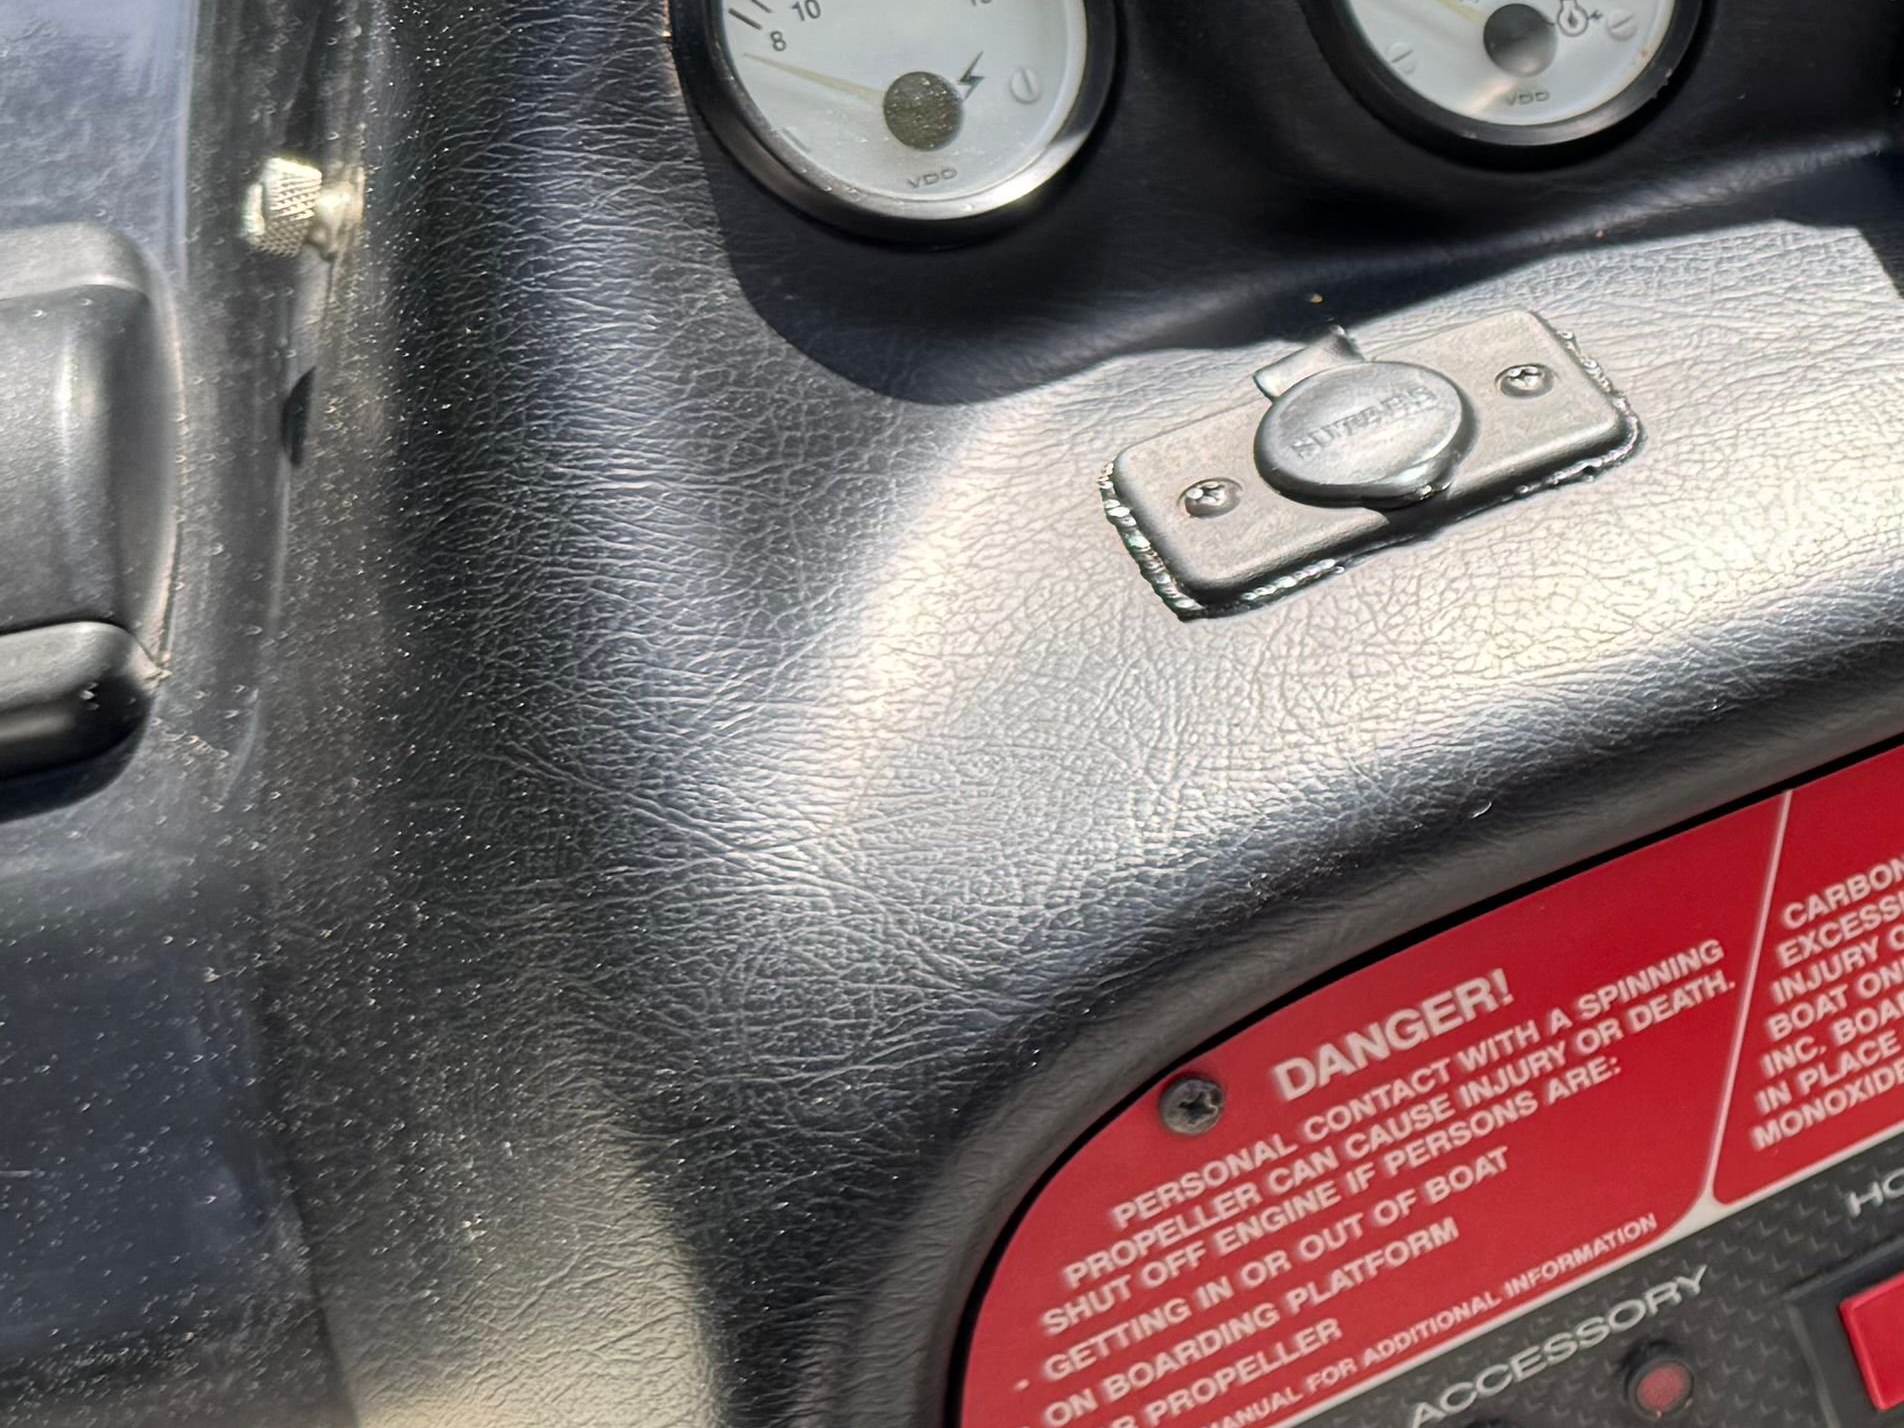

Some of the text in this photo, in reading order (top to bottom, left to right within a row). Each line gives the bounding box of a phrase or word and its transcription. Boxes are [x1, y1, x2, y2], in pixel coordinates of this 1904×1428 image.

[770, 31, 786, 52] 8
[792, 0, 822, 22] 10
[1271, 967, 1513, 1101] DANGER!
[1766, 983, 1848, 1041] BOAT
[1770, 935, 1879, 1004] INJURY
[1109, 938, 1724, 1230] PERSONAL CONTACT WITH A SPINNING
[1755, 1079, 1792, 1114] IN
[1795, 1029, 1901, 1095] PLACE
[1760, 1034, 1826, 1078] INC.
[1039, 1055, 1621, 1336] SHUT OFF ENGINE IF PERSONS ARE:
[1061, 969, 1735, 1289] PROPELLER CAN CAUSE INJURY OR DEATH.
[1041, 1145, 1508, 1381] GETTING IN OR OUT OF BOAT
[1041, 1215, 1459, 1428] ON BOARDING PLATFORM
[1302, 1356, 1358, 1394] FOR
[1359, 1290, 1502, 1368] ADDITIONAL
[1502, 1212, 1657, 1298] INFORMATION
[1142, 1317, 1343, 1427] PROPELLER
